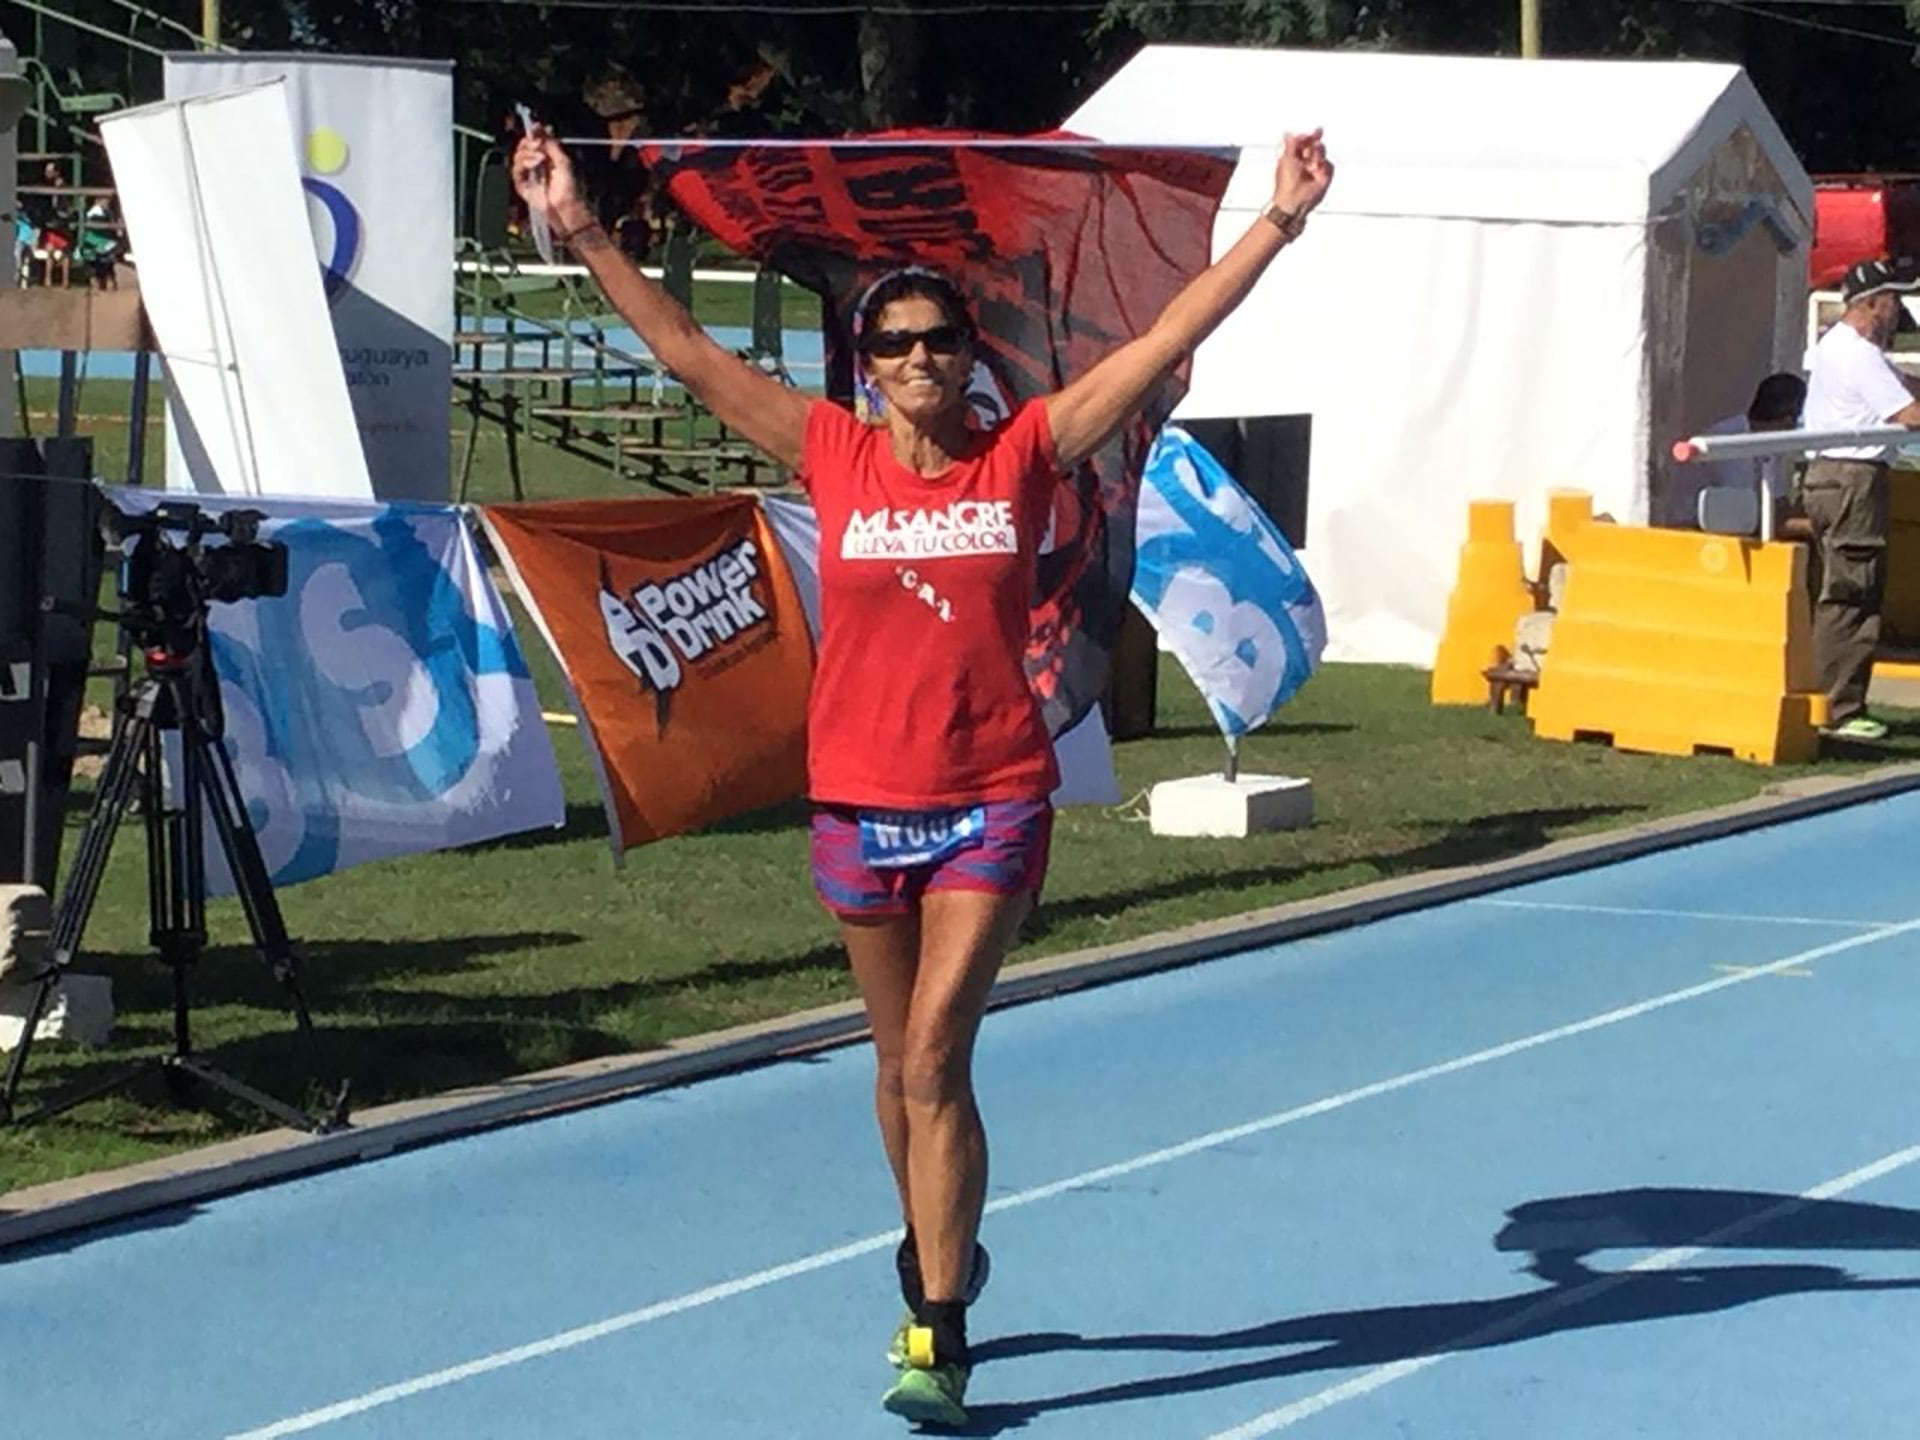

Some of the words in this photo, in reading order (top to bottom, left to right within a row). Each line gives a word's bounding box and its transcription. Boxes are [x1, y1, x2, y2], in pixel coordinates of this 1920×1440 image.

[940, 530, 1008, 552] COLOR
[633, 539, 758, 631] Power
[665, 585, 768, 661] Drink
